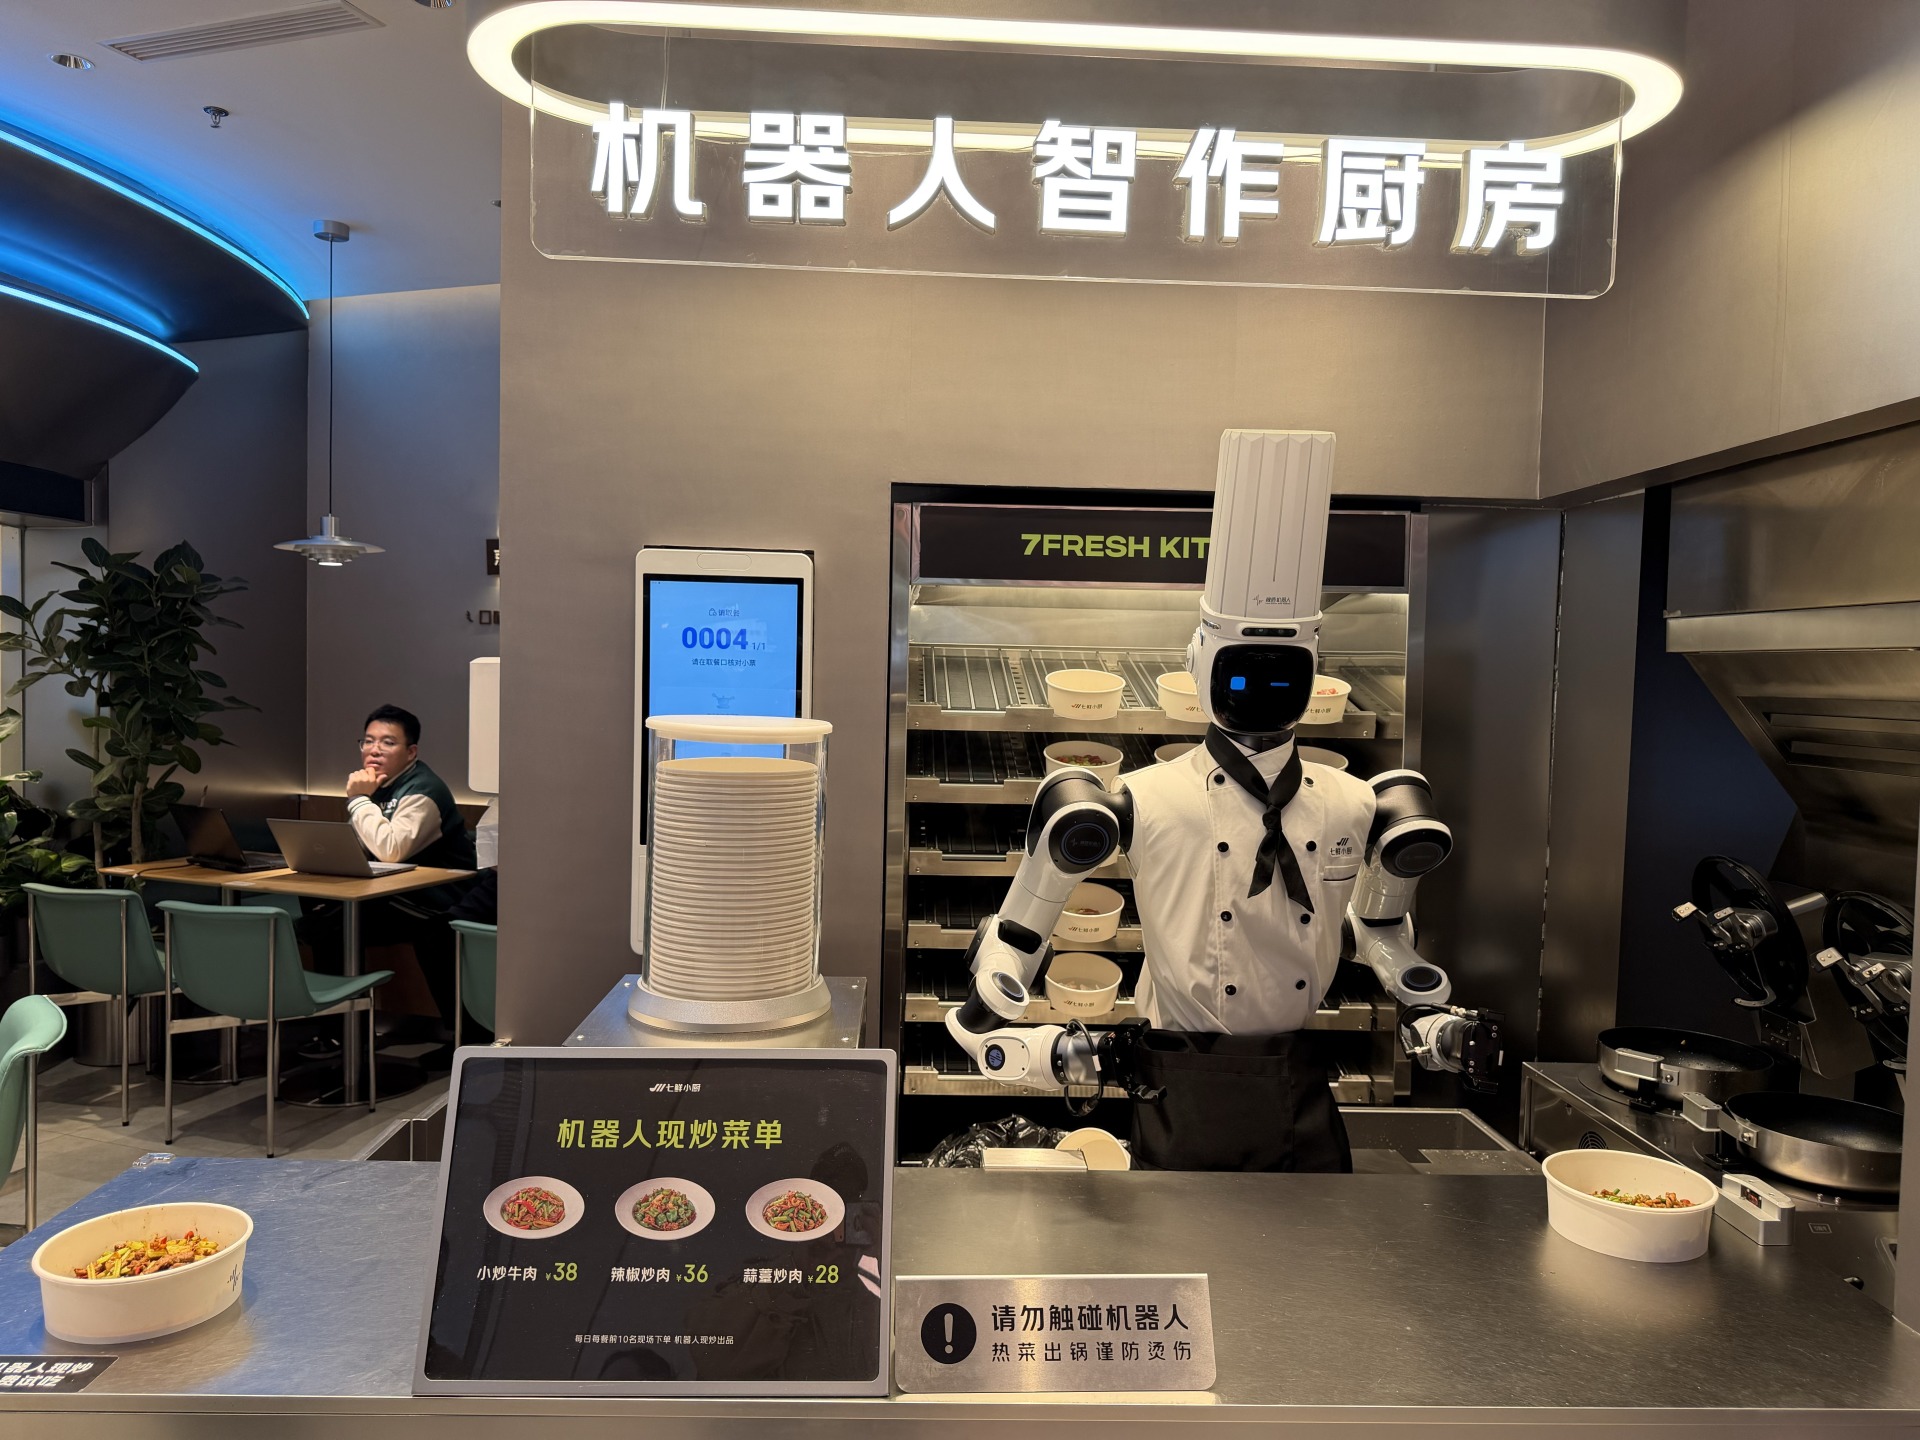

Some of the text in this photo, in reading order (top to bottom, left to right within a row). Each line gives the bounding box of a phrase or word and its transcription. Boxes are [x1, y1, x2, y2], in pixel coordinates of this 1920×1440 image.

[590, 101, 1565, 255] 机器人智作厨房
[1021, 533, 1150, 558] 7FRESH
[681, 626, 766, 650] 0004 1/1
[691, 658, 757, 667] 请在取餐口核对小票
[666, 1083, 701, 1093] 七鲜小厨
[556, 1118, 783, 1150] 机器人现炒菜单
[476, 1265, 538, 1281] 小炒牛肉
[610, 1267, 671, 1283] 辣椒炒肉
[991, 1304, 1189, 1332] 请勿触碰机器人
[574, 1334, 734, 1345] 每日每餐前10名现场下单 机器人现炒出品
[991, 1340, 1192, 1362] 热菜出锅谨防烫伤
